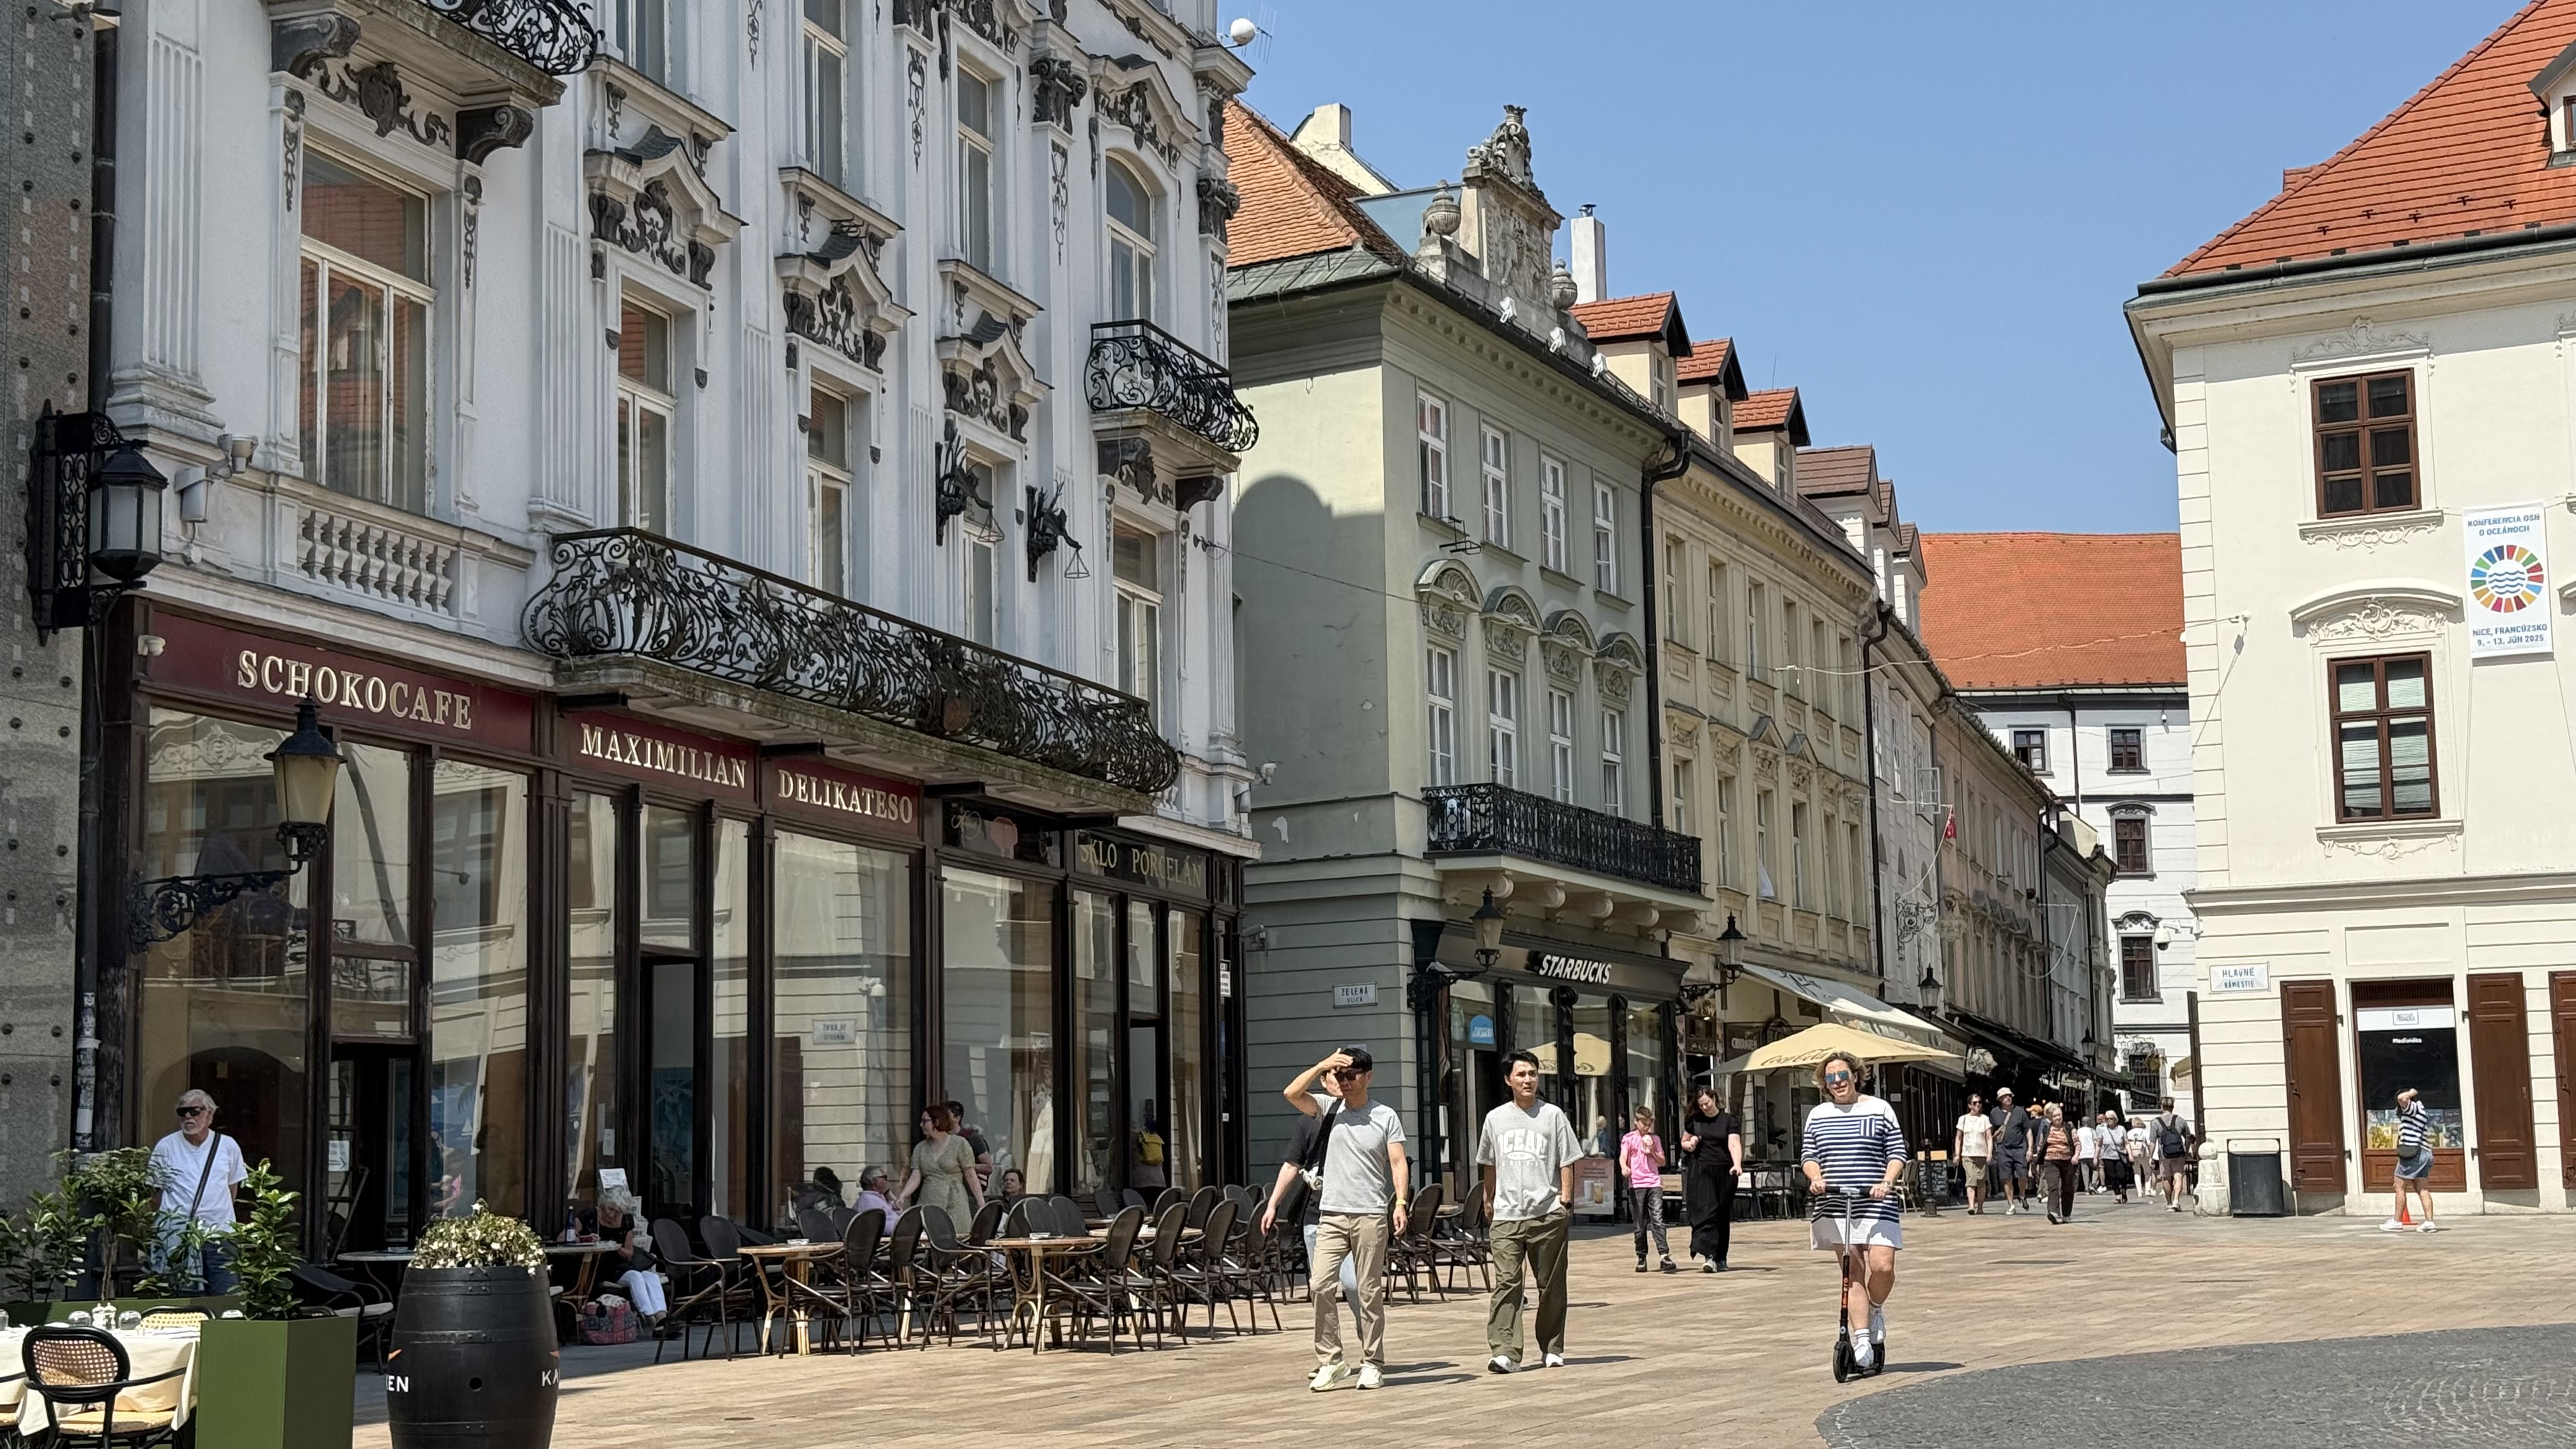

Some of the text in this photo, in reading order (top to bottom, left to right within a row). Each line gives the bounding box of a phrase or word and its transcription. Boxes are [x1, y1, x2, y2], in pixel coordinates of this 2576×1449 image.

[2495, 624, 2547, 635] FRANCÚZSKO
[2524, 634, 2544, 643] 2025
[238, 650, 471, 730] SCHOKOCAFE
[580, 723, 747, 788] MAXIMILIAN
[778, 769, 913, 824] DELIKATESO
[1080, 838, 1202, 889] SKLO PORCELÁN
[1539, 954, 1613, 985] STARBUCKS
[2222, 966, 2255, 978] HLAVNÉ
[2224, 979, 2255, 988] NÁMESTIE
